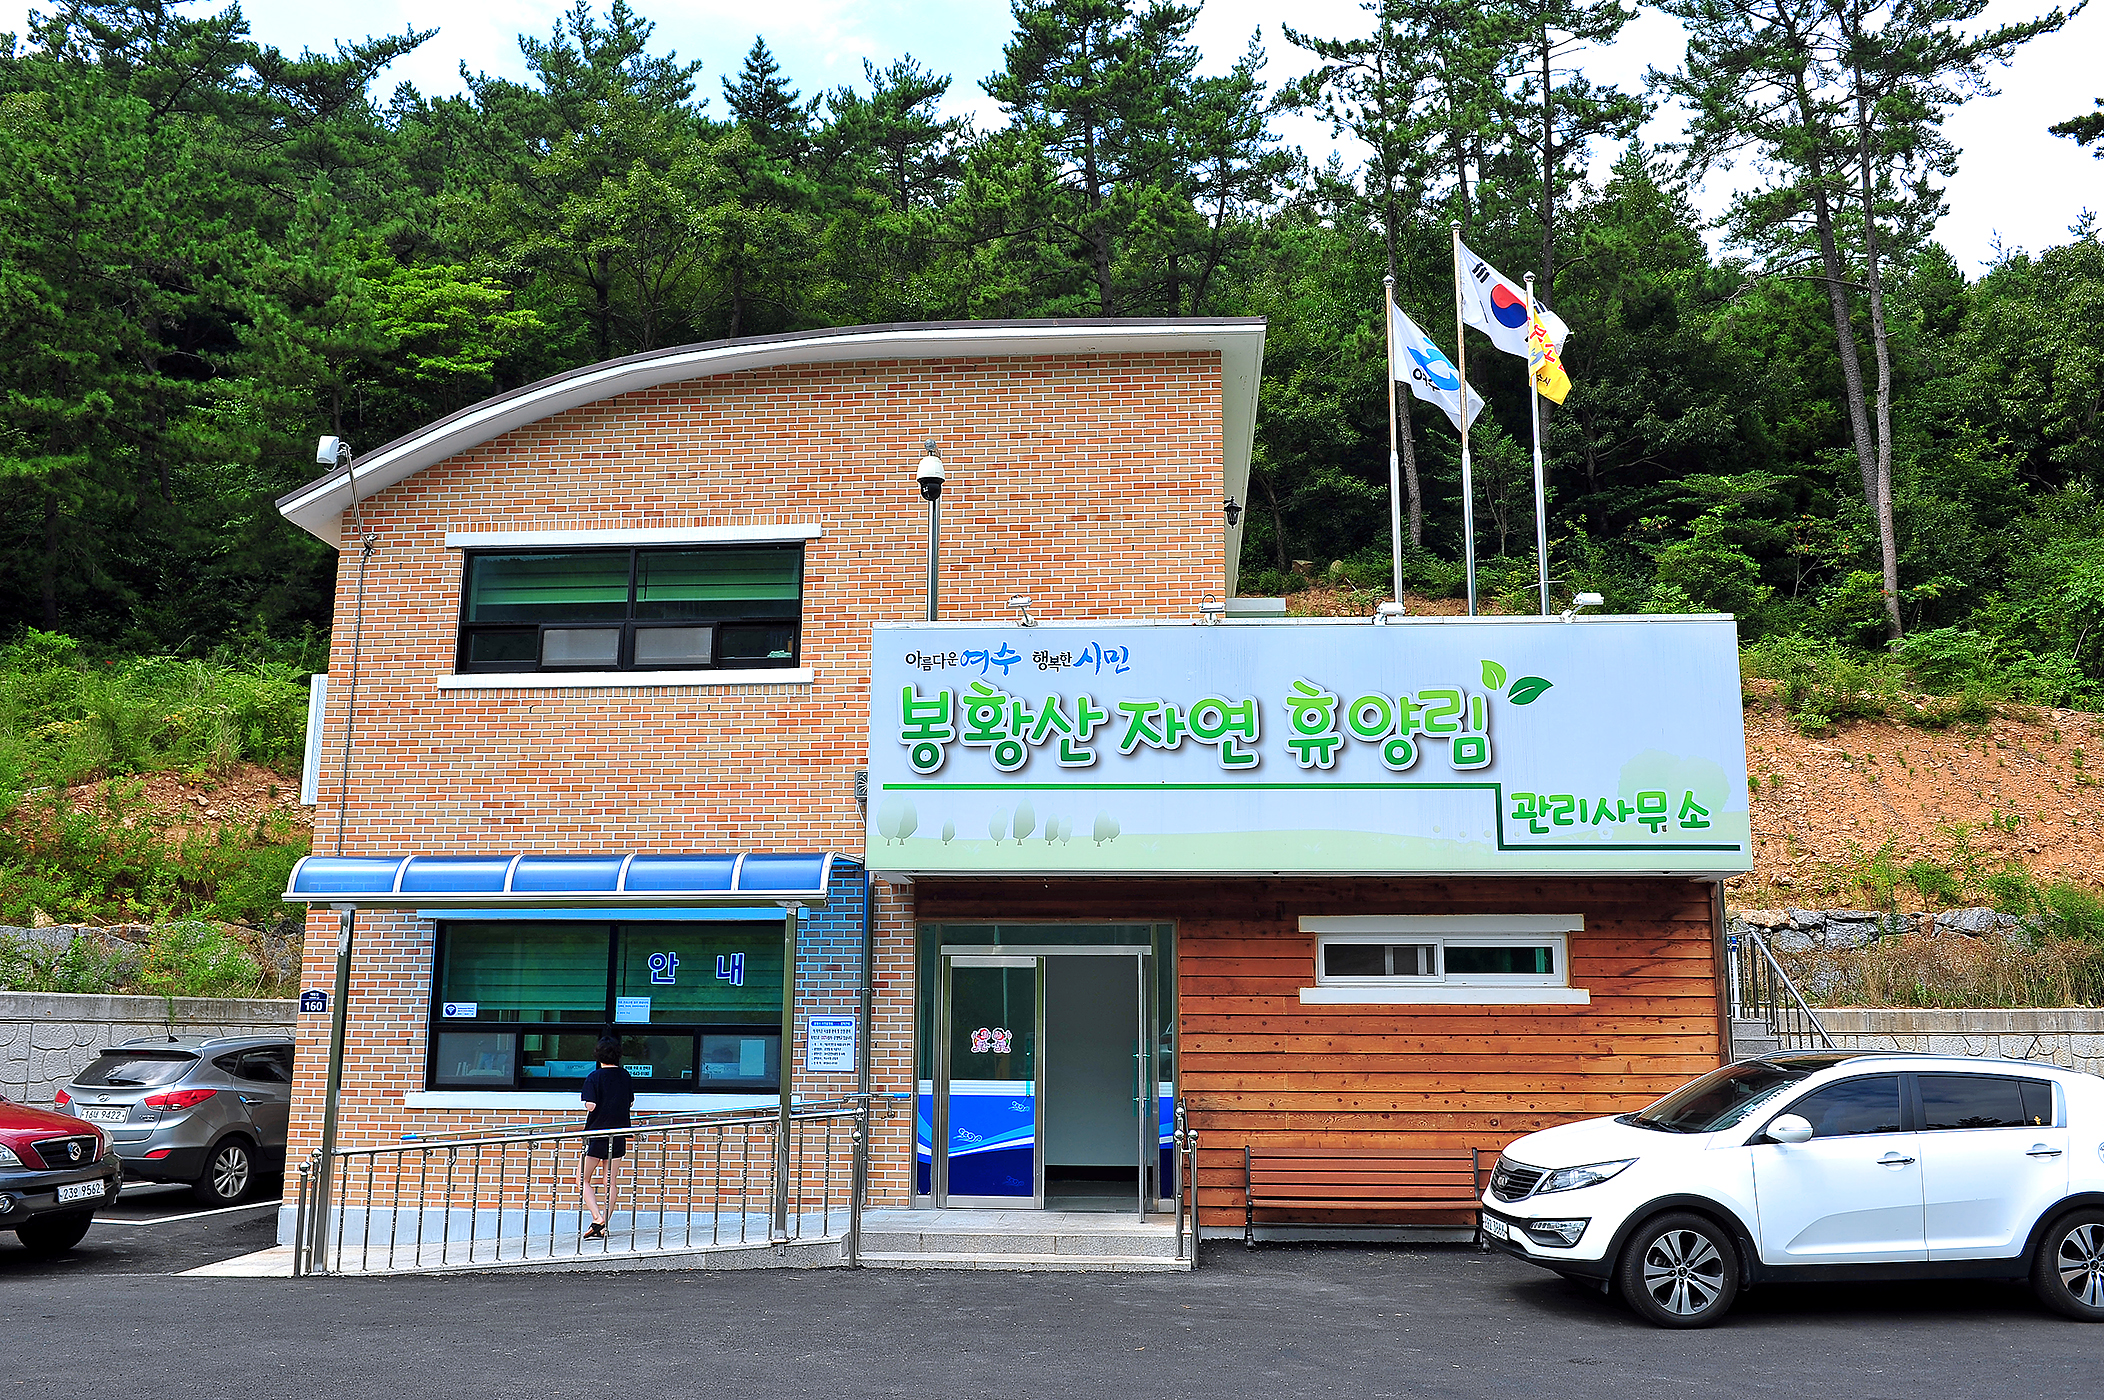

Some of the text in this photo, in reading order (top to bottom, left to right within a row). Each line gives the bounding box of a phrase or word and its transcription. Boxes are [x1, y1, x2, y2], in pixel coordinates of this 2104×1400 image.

[901, 680, 1488, 769] 봉황산 자연 휴양림
[1511, 790, 1711, 834] 관리사무소
[305, 1001, 323, 1011] 160
[81, 1183, 101, 1196] 9562
